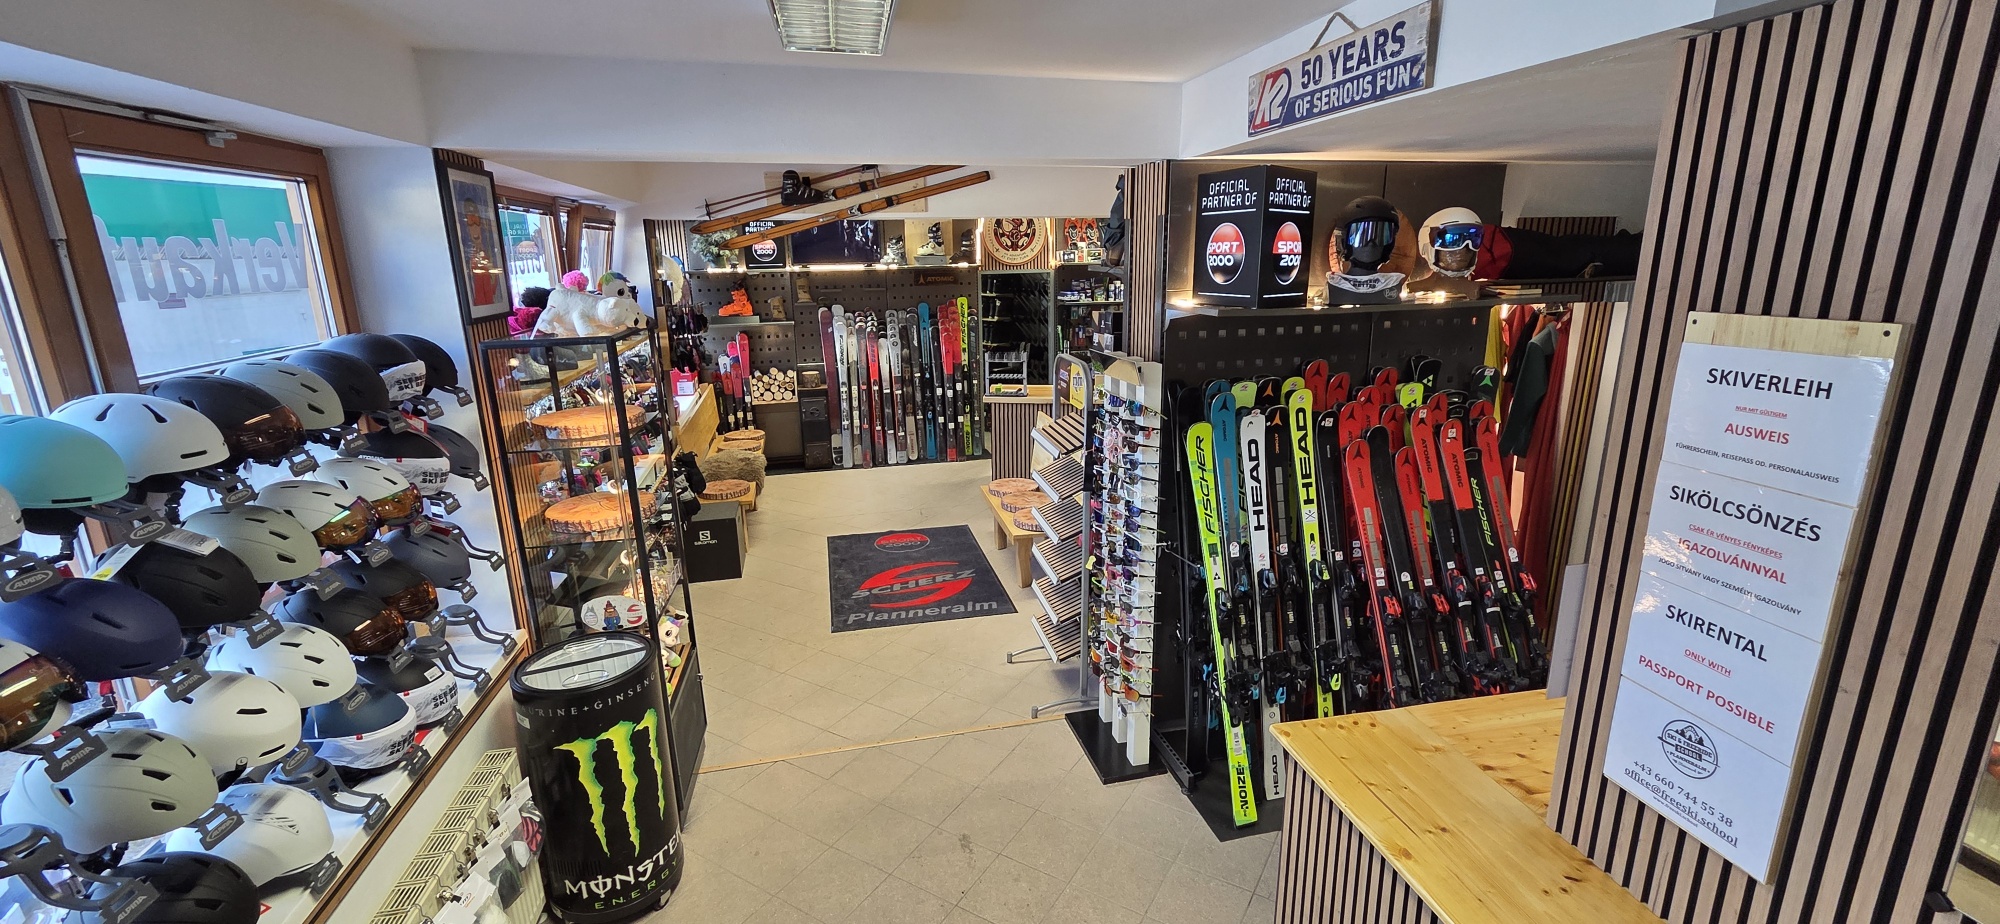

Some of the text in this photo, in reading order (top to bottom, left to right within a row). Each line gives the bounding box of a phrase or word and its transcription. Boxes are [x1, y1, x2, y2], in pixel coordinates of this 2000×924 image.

[1301, 21, 1407, 90] 50 YEARS
[1254, 68, 1291, 127] K2
[1295, 62, 1411, 118] OF SERIOUS FUN
[1202, 192, 1258, 209] PARTNER OF
[1209, 178, 1250, 196] OFFICIAL
[1269, 192, 1312, 208] PARTNER OF
[1276, 177, 1307, 193] OFFICIAL
[1208, 241, 1240, 253] SPORT
[1208, 255, 1234, 266] 2000
[959, 301, 968, 345] FISCHER
[1706, 367, 1833, 400] SKIVERLEIH
[1759, 408, 1788, 418] GÜLTIGEM
[1724, 423, 1790, 445] AUSWEIS
[1295, 407, 1315, 506] HEAD
[1420, 438, 1433, 474] ATOMIC
[1451, 453, 1464, 488] ATOMIC
[1675, 442, 1840, 484] FÜHRERSCHEIN, REISEPASS OD. PERSONALAUSWEIS
[231, 490, 247, 502] ALPINA
[1195, 435, 1216, 535] FISCHER
[1247, 438, 1265, 532] HEAD
[1471, 477, 1494, 546] FISCHER
[1669, 485, 1822, 542] SIKÖLCSÖNZÉS
[136, 523, 161, 537] ALPINA
[880, 536, 923, 545] SPORT
[884, 541, 921, 549] 2000
[1688, 523, 1783, 559] CSAK ÉR VÉNYES FÉNYKÉPES
[1678, 537, 1787, 584] IGAZOLVÁNNYAL
[13, 573, 47, 590] ALPINA
[851, 569, 977, 600] SCHERZ
[1658, 557, 1675, 568] JOGO
[1676, 561, 1701, 578] SITVÁNY
[1702, 573, 1721, 585] VAGY
[1753, 593, 1801, 616] IGAZOLVÁNY
[847, 601, 999, 625] Planneralm
[256, 626, 277, 641] ALPINA
[1665, 604, 1768, 662] SKIRENTAL
[1684, 648, 1732, 677] ONLY WITH
[176, 674, 202, 693] ALPINA
[1638, 654, 1775, 734] PASSPORT POSSIBLE
[1666, 732, 1677, 741] SKI
[1676, 745, 1701, 760] SCHOOL
[60, 746, 95, 771] ALPINA
[1236, 767, 1249, 810] NOIZE
[1272, 754, 1280, 796] HEAD
[1624, 767, 1738, 847] office@freeski.school
[1633, 761, 1733, 828] +43 660 744 55 38
[211, 820, 234, 839] ALPINA
[595, 858, 678, 910] ENERGY
[116, 895, 148, 924] ALPINA
